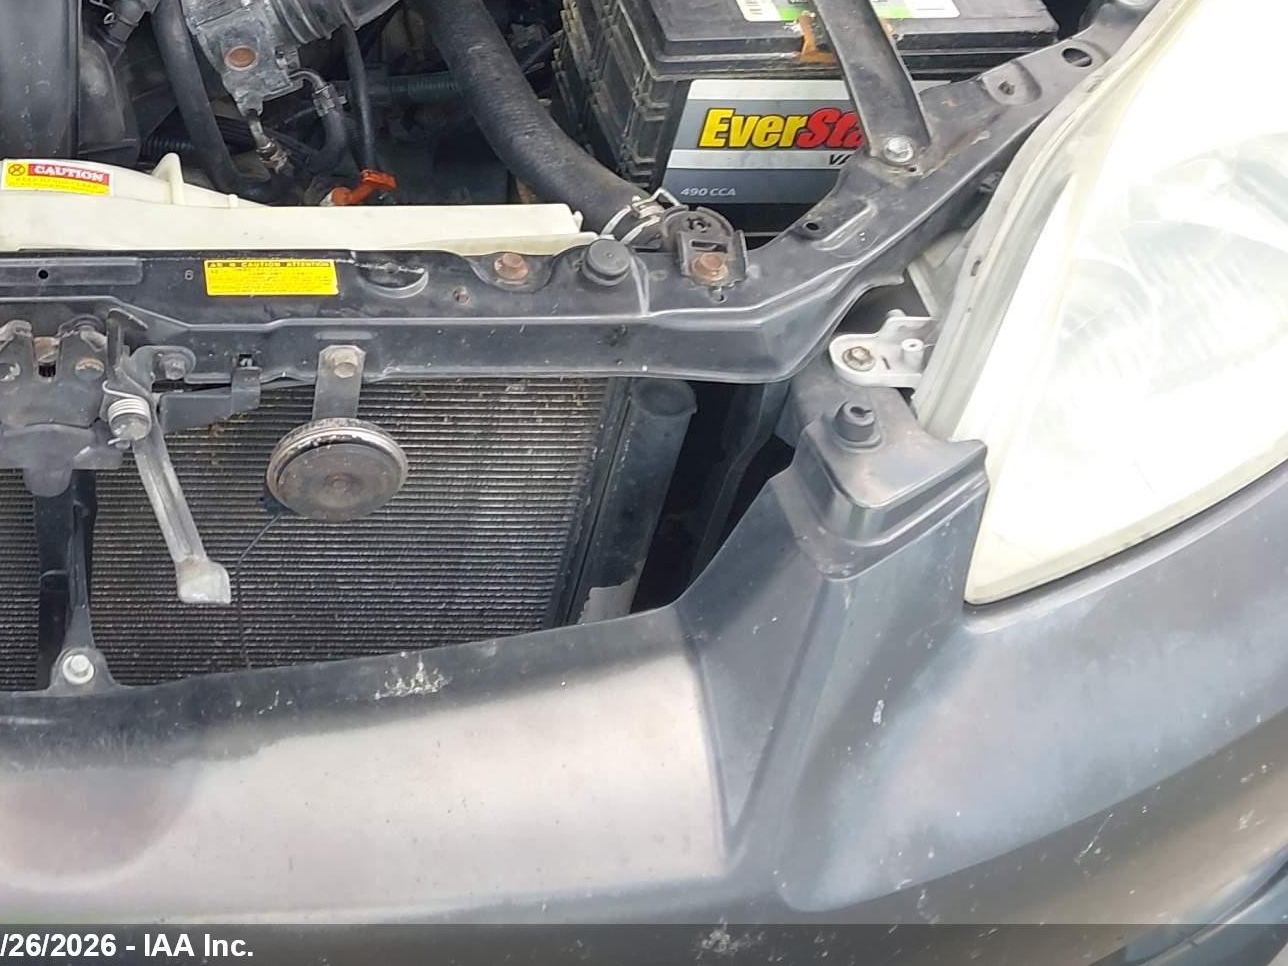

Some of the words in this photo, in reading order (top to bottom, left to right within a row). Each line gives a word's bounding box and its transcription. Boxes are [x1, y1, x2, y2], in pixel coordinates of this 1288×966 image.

[33, 165, 105, 182] CAUTION
[679, 187, 708, 197] 490
[709, 187, 737, 197] CCA
